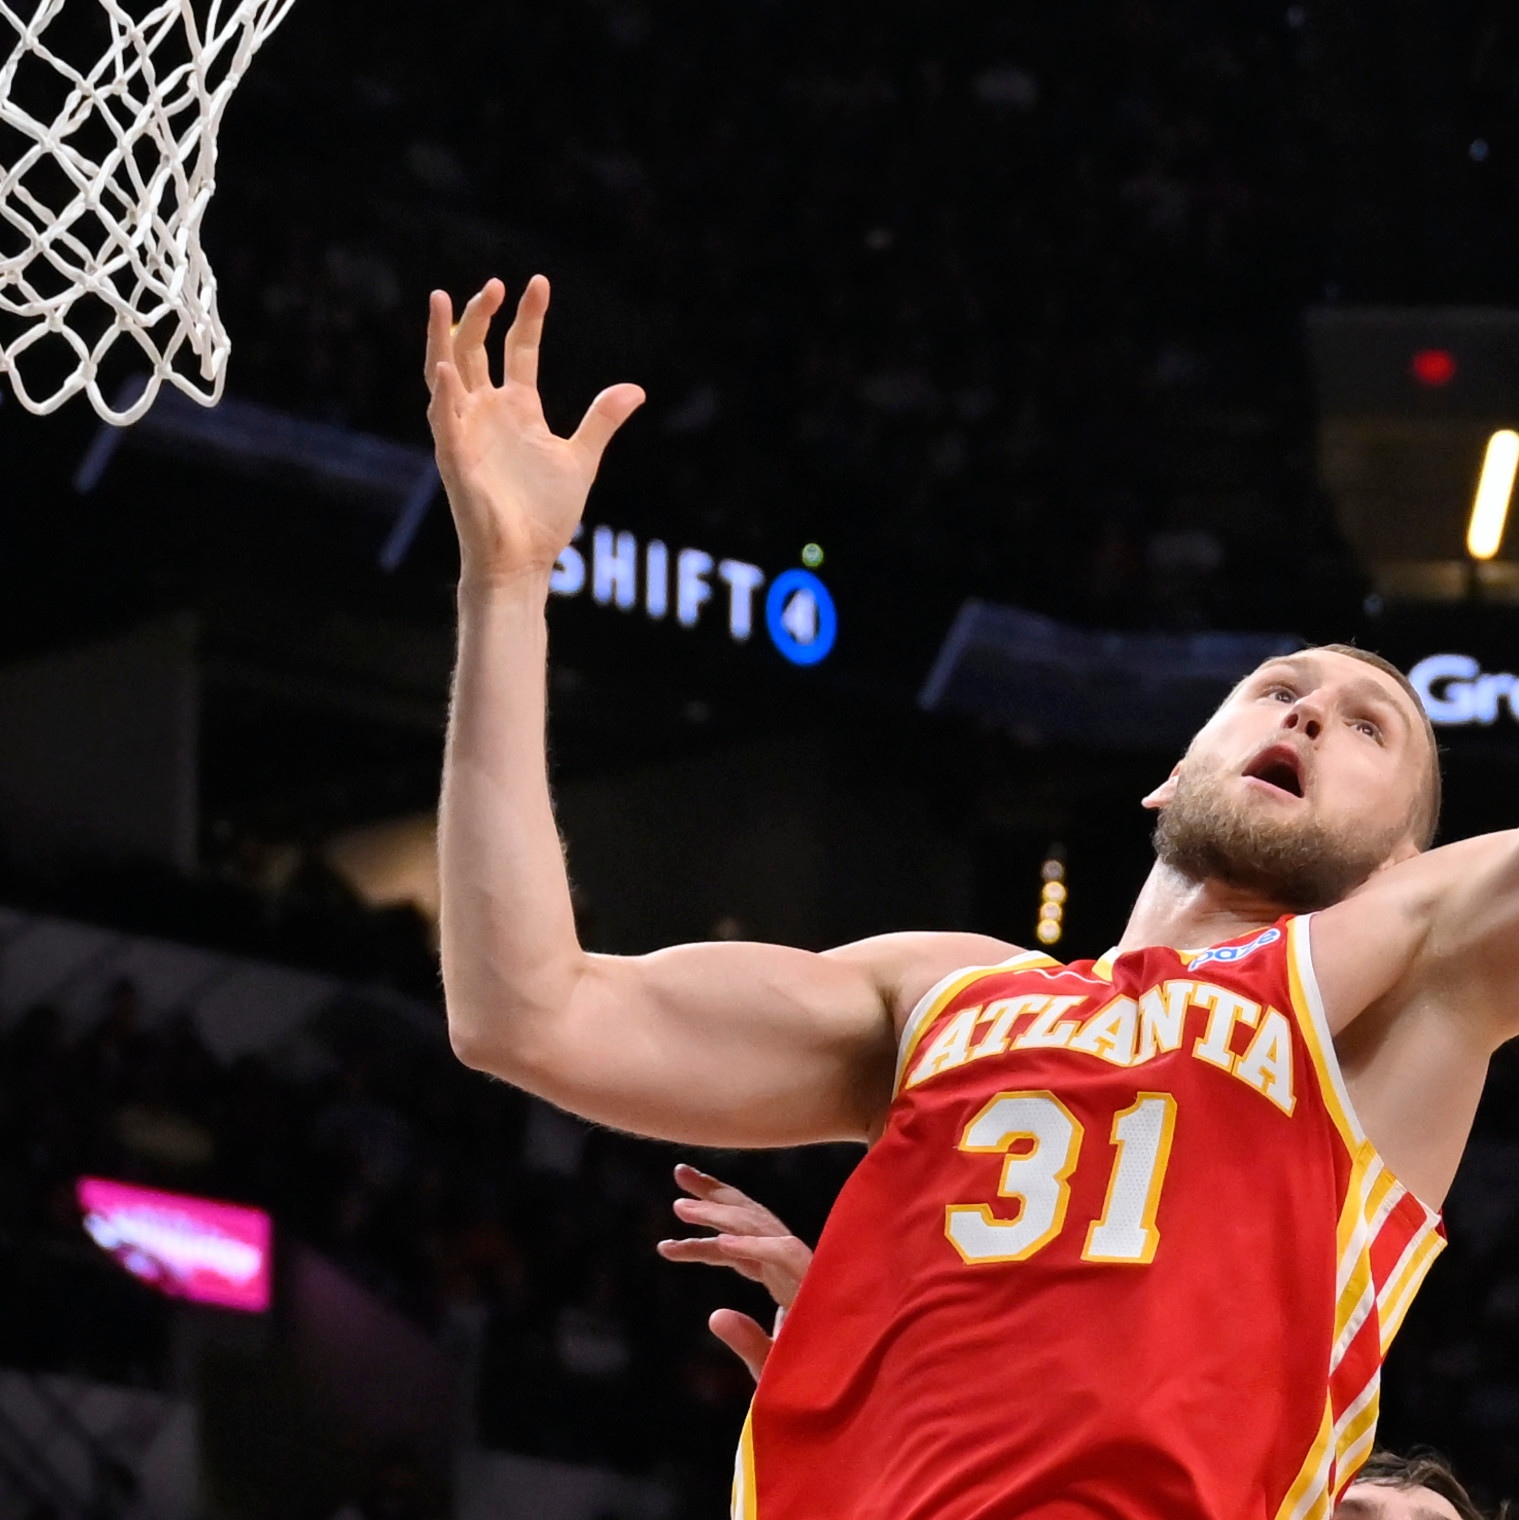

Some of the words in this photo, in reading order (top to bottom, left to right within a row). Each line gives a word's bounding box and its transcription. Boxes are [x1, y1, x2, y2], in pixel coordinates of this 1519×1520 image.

[1190, 930, 1278, 970] paze
[905, 979, 1297, 1117] ATLANTA
[944, 1090, 1177, 1264] 31
